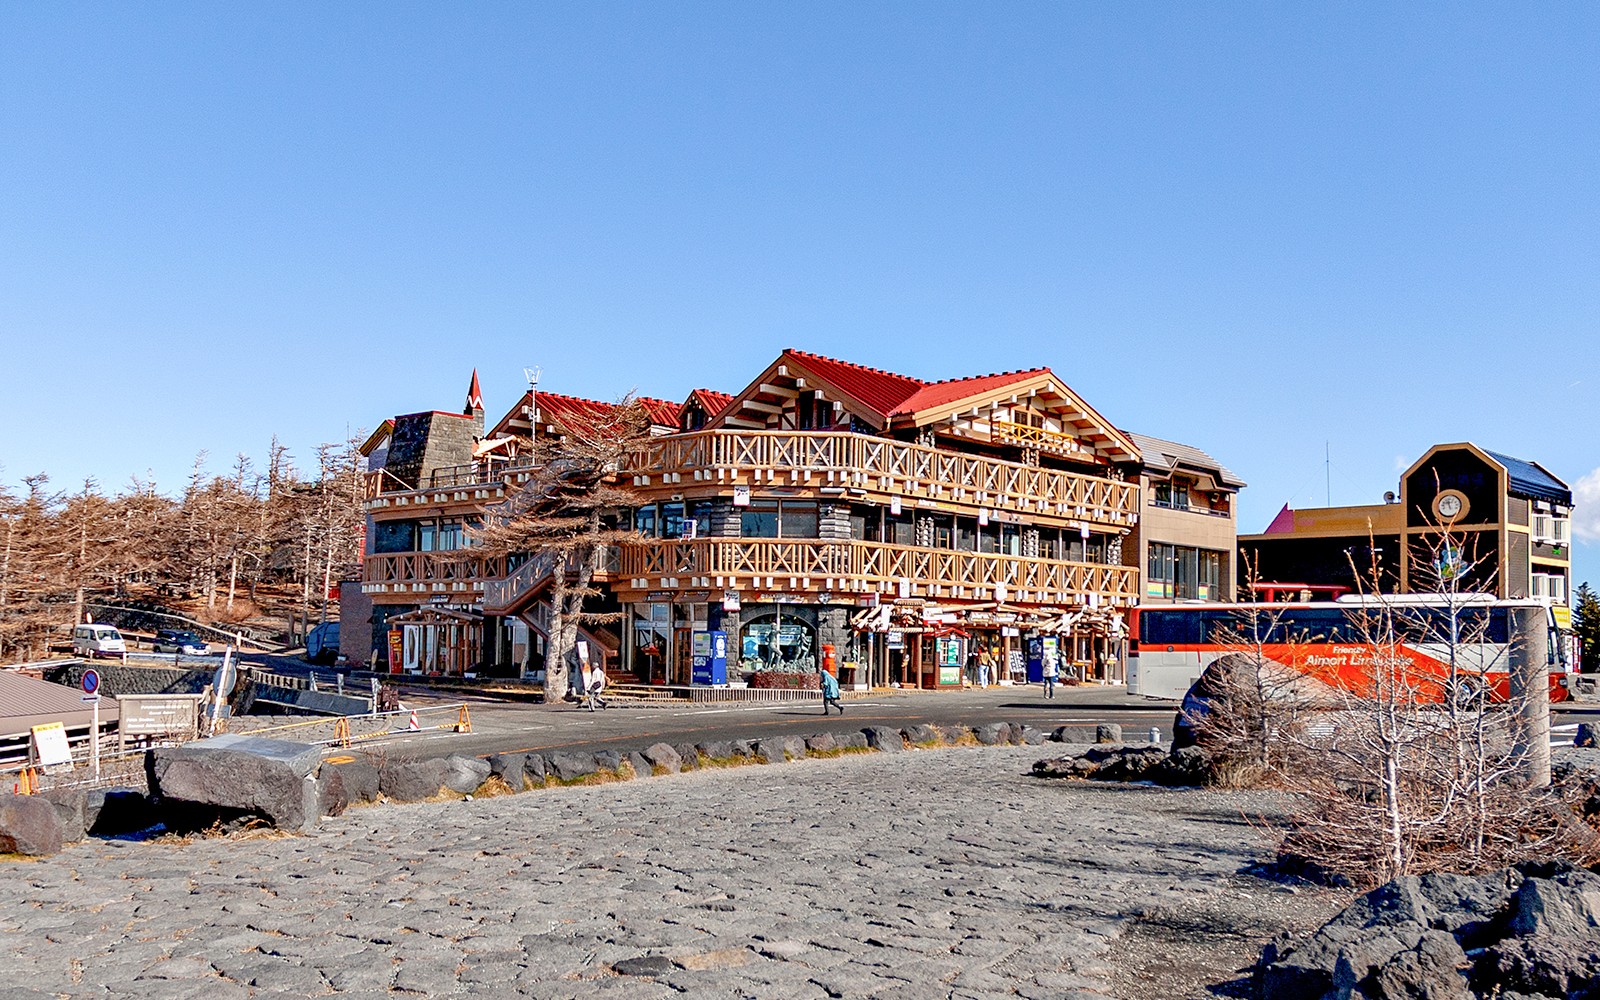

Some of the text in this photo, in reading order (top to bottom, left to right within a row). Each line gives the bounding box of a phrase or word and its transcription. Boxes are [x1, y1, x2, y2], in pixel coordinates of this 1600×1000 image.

[1332, 645, 1367, 654] Friendly
[1305, 654, 1413, 667] Airport Limue
